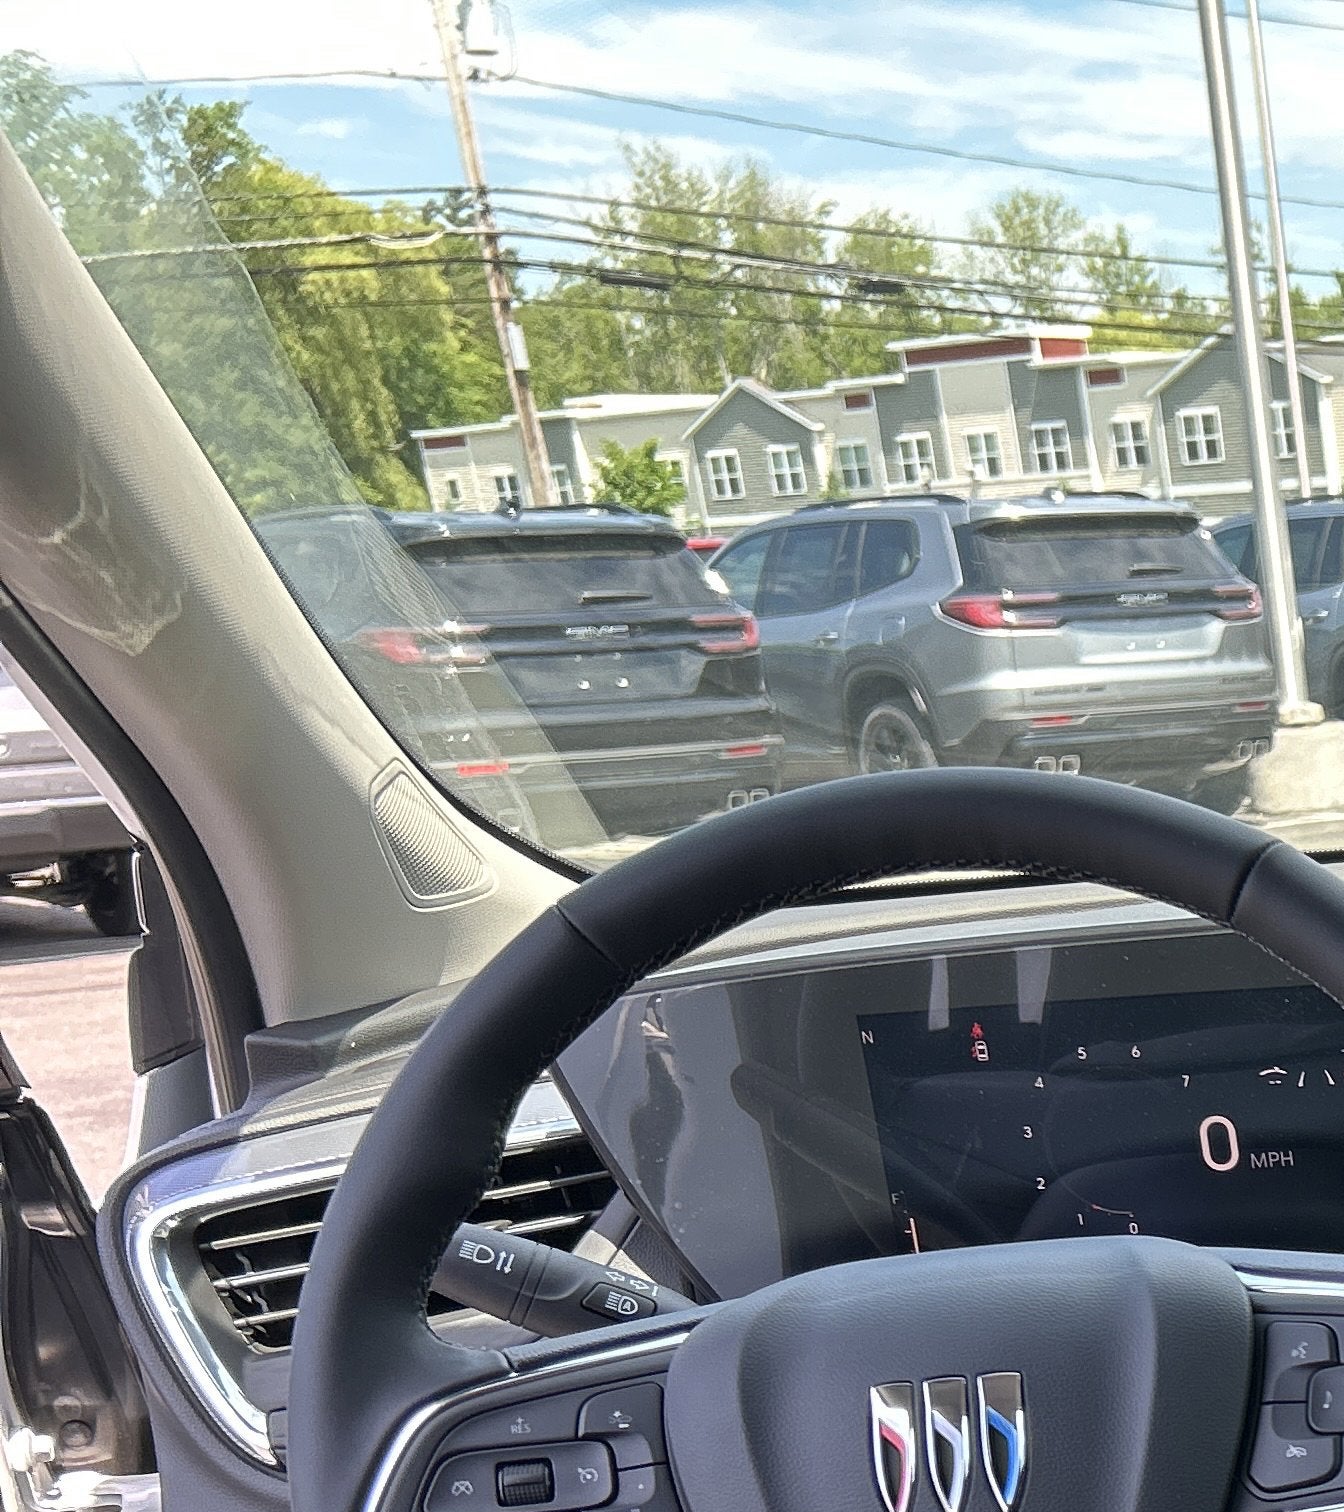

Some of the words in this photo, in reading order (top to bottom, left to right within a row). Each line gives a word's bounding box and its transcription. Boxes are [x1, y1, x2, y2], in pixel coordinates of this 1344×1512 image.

[861, 1030, 874, 1045] N
[1077, 1046, 1088, 1060] 5
[1131, 1045, 1141, 1059] 6
[1033, 1075, 1045, 1089] 4
[1181, 1073, 1191, 1088] 7
[1022, 1125, 1033, 1139] 3
[1199, 1114, 1240, 1172] 0
[1250, 1150, 1295, 1171] MPH
[1036, 1177, 1046, 1190] 2
[1077, 1213, 1085, 1226] 1
[1128, 1222, 1139, 1235] 0
[510, 1424, 531, 1434] RES
